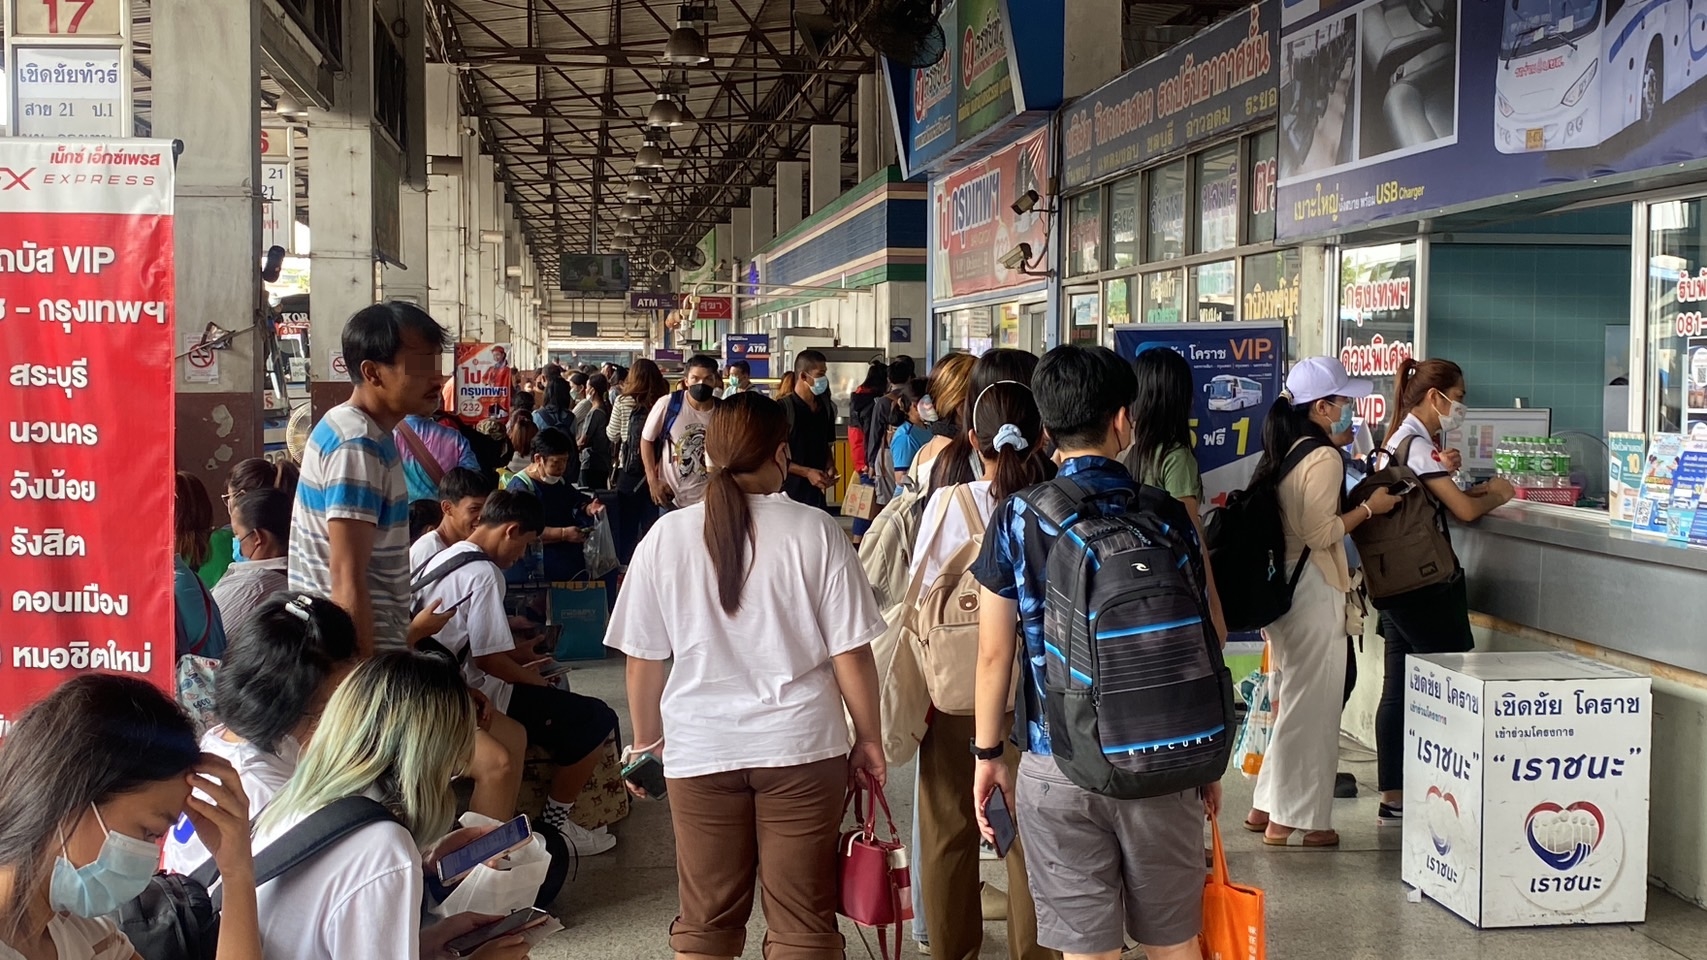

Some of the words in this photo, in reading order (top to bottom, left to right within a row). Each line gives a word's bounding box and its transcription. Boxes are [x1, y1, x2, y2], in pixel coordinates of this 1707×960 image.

[43, 0, 95, 33] 17
[19, 62, 118, 83] เชิดชัยทัวร์
[25, 102, 52, 116] สาย
[59, 103, 75, 116] 21
[92, 103, 114, 117] ป.1
[51, 146, 84, 164] เน็กซ์
[87, 146, 160, 166] เอ็กซ์เพรส
[43, 174, 155, 186] EXPRESS
[268, 168, 283, 180] 21
[951, 168, 1001, 248] กรุงเทพฯ
[1294, 183, 1340, 222] เบาะใหญ่
[1376, 181, 1399, 205] USB
[1399, 185, 1425, 201] Charger
[62, 246, 115, 274] VIP
[38, 298, 165, 333] กรุงเทพฯ
[638, 299, 658, 307] ATM
[1344, 278, 1411, 327] กรุงเทพฯ
[747, 345, 767, 353] ATM
[1189, 344, 1226, 360] โคราช
[9, 357, 88, 398] สระบุรี
[462, 367, 481, 384] ไป
[461, 387, 507, 399] กรุงเทพฯ
[463, 403, 480, 412] 232
[1357, 395, 1385, 425] VIP
[9, 421, 98, 445] นวนคร
[1203, 427, 1226, 446] ฟรี
[1231, 416, 1250, 456] 1
[9, 469, 96, 502] วังน้อย
[11, 526, 85, 556] รังสิต
[12, 582, 128, 616] ดอนเมือง
[12, 640, 151, 673] หมอชิตใหม่
[1410, 666, 1441, 699] เชิดชัย
[1494, 692, 1562, 716] เชิดชัย
[1574, 690, 1640, 715] โคราช
[1495, 726, 1574, 739] เข้าร่วมโครงการ
[1426, 854, 1458, 884] เราชนะ
[1530, 875, 1602, 893] เราชนะ
